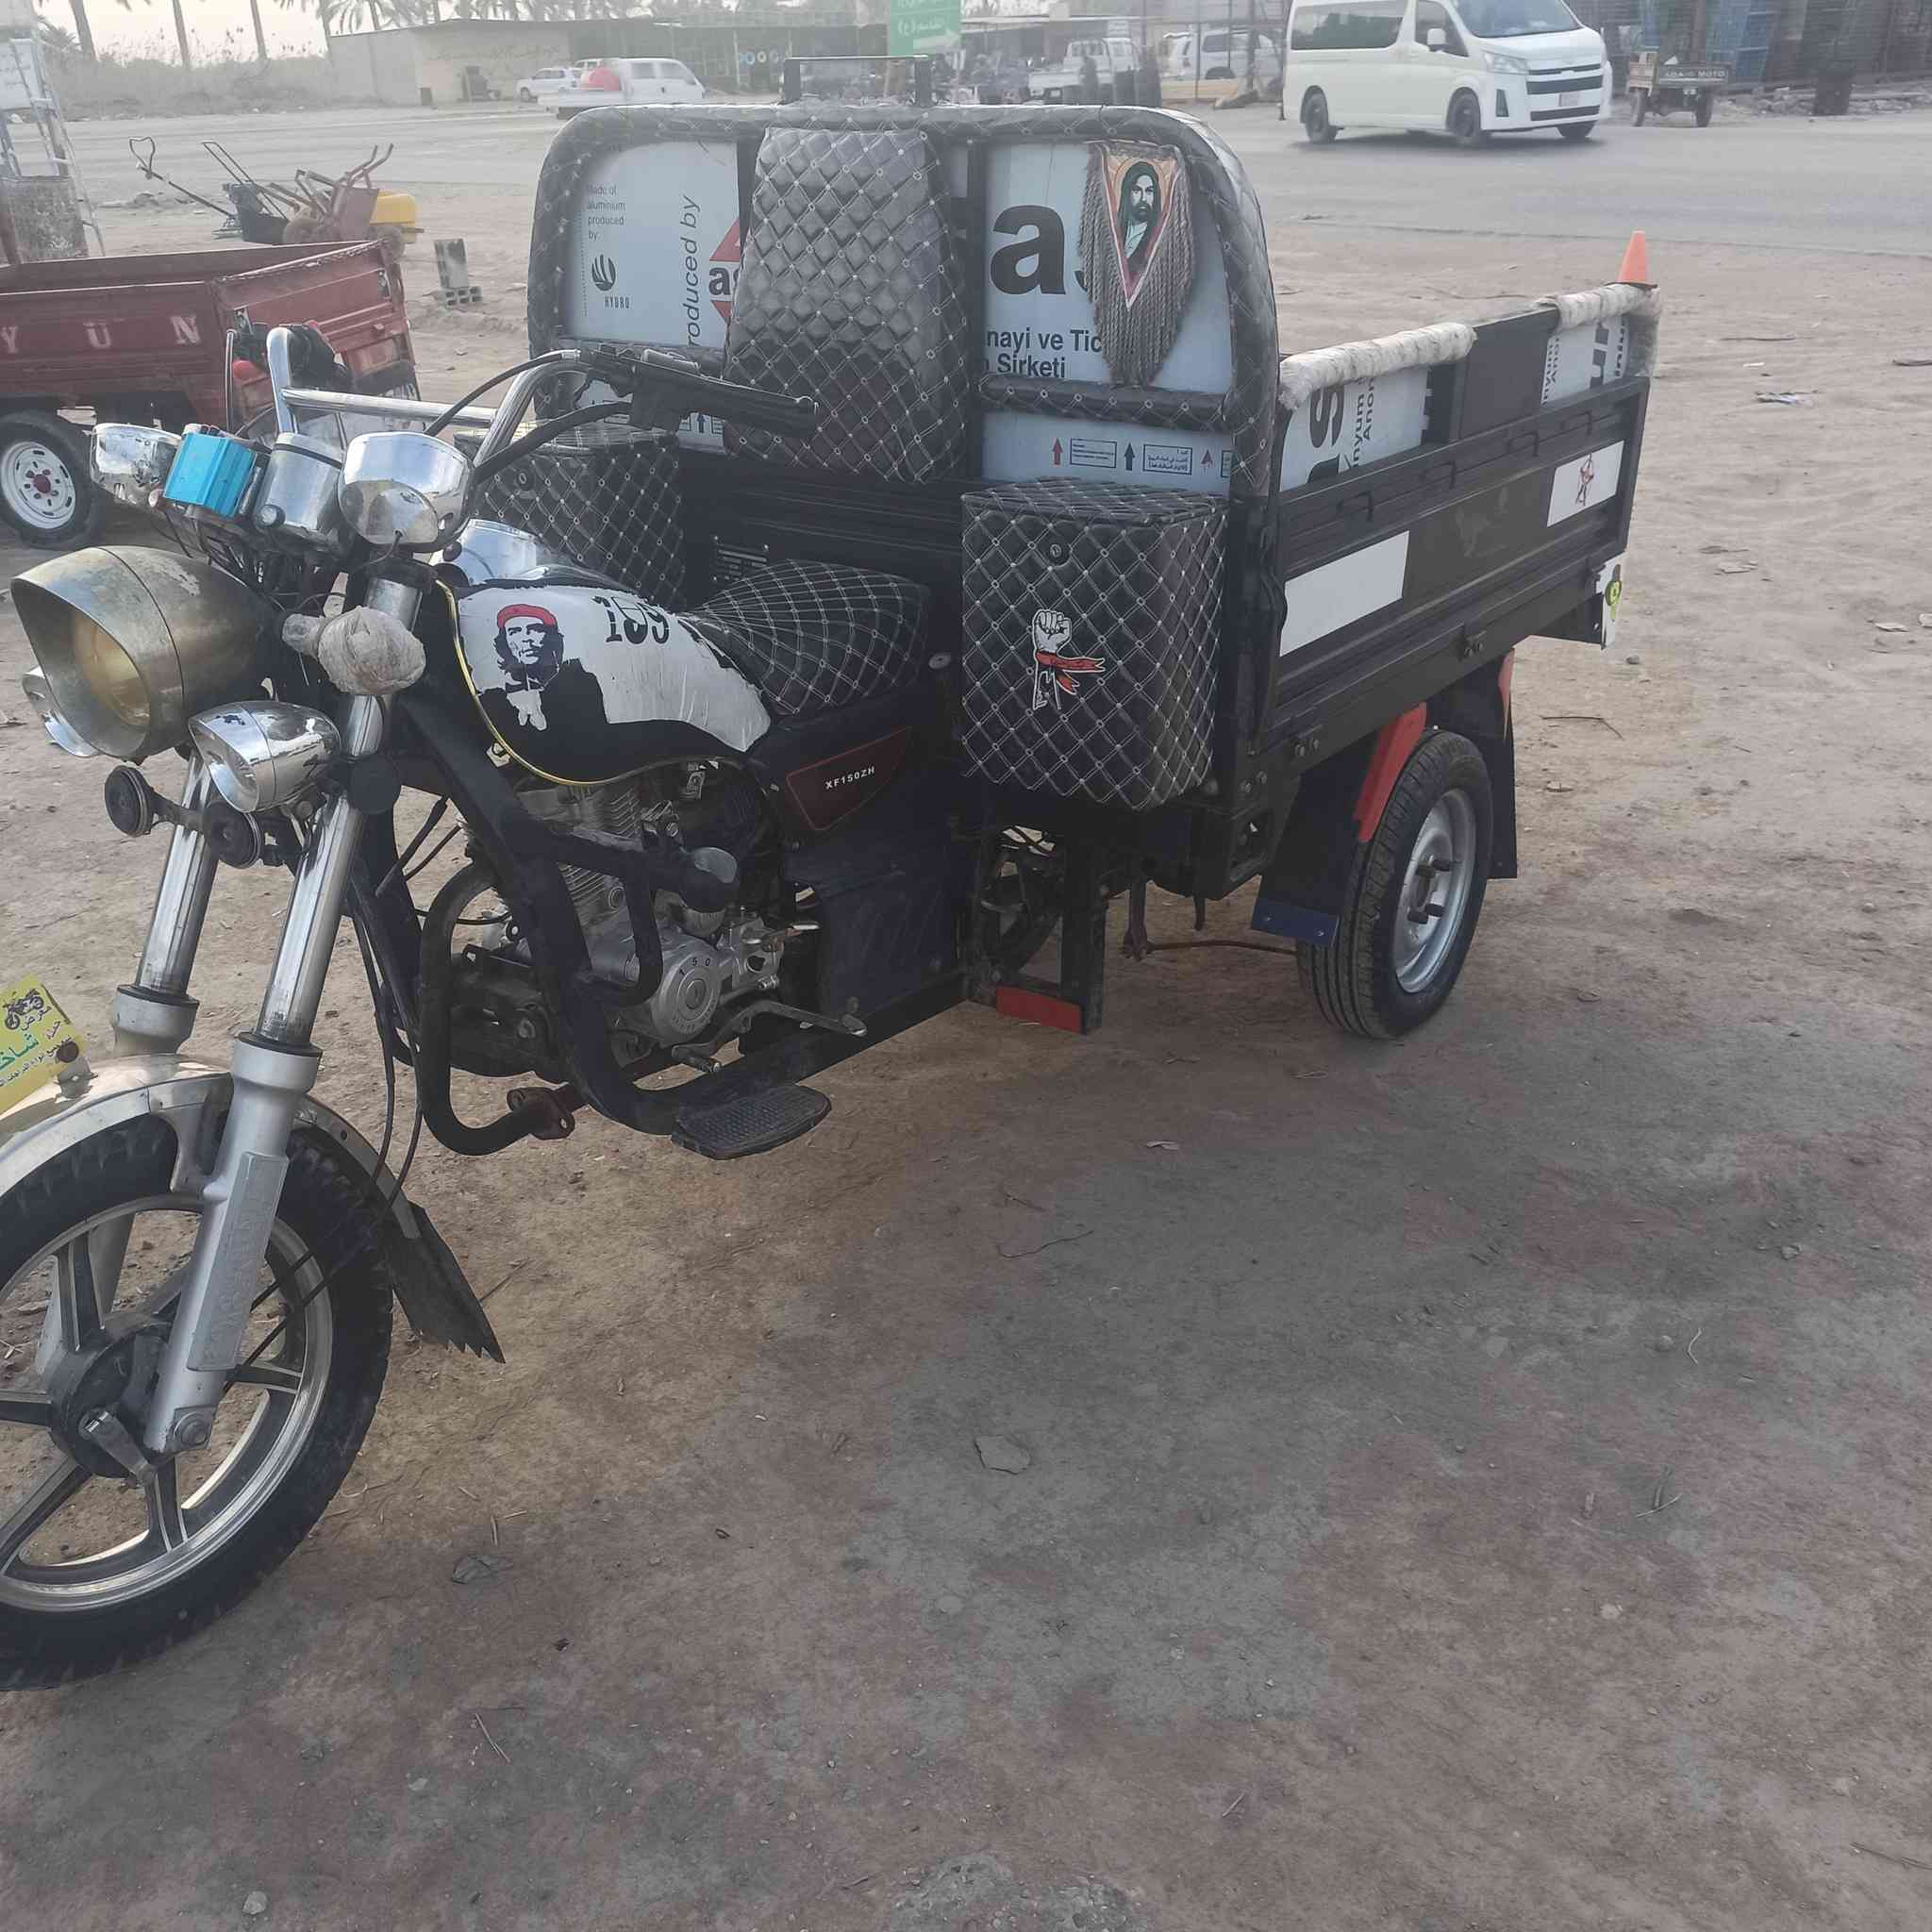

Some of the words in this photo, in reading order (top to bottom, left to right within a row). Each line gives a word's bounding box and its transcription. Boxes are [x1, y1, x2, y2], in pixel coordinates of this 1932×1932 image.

[681, 193, 701, 228] by
[588, 216, 625, 227] produced
[588, 230, 598, 242] by
[605, 296, 630, 309] HYDRO
[1038, 332, 1064, 350] ve
[824, 765, 875, 791] XF150ZH
